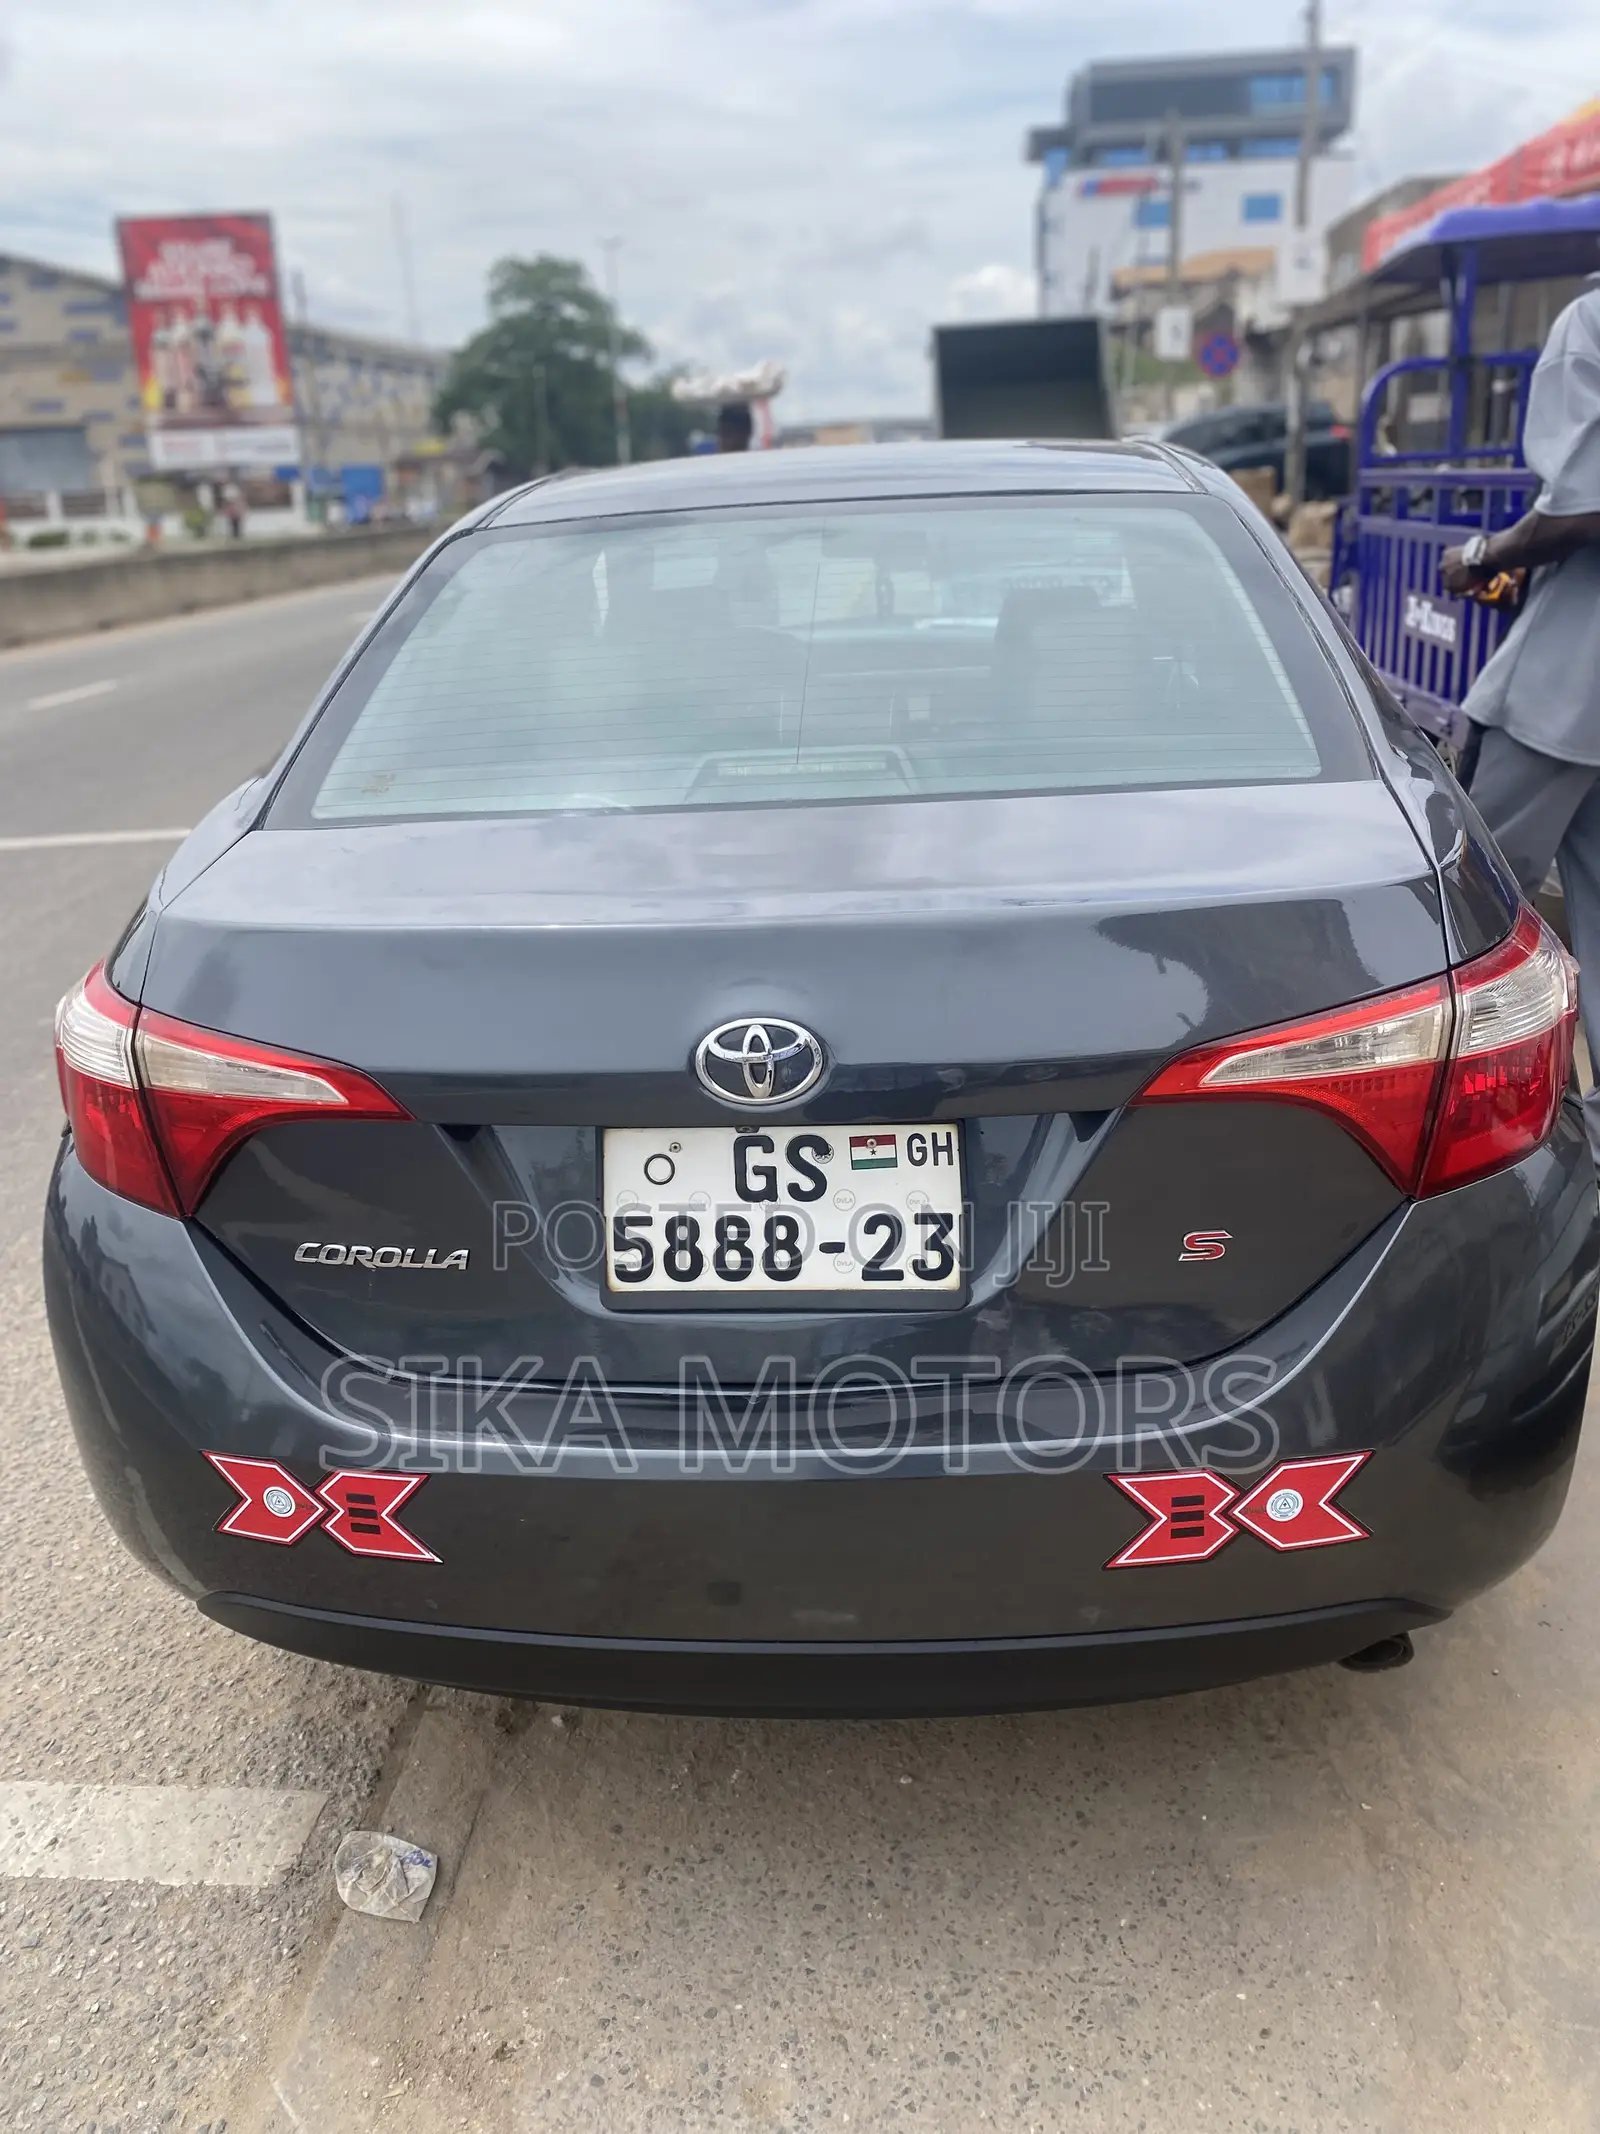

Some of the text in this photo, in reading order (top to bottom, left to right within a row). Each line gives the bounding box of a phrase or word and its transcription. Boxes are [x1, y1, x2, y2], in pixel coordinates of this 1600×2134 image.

[907, 1131, 954, 1167] GH
[733, 1134, 832, 1203] GS
[294, 1241, 470, 1271] COROLLA
[613, 1212, 955, 1283] 5888-23
[1178, 1229, 1233, 1262] S
